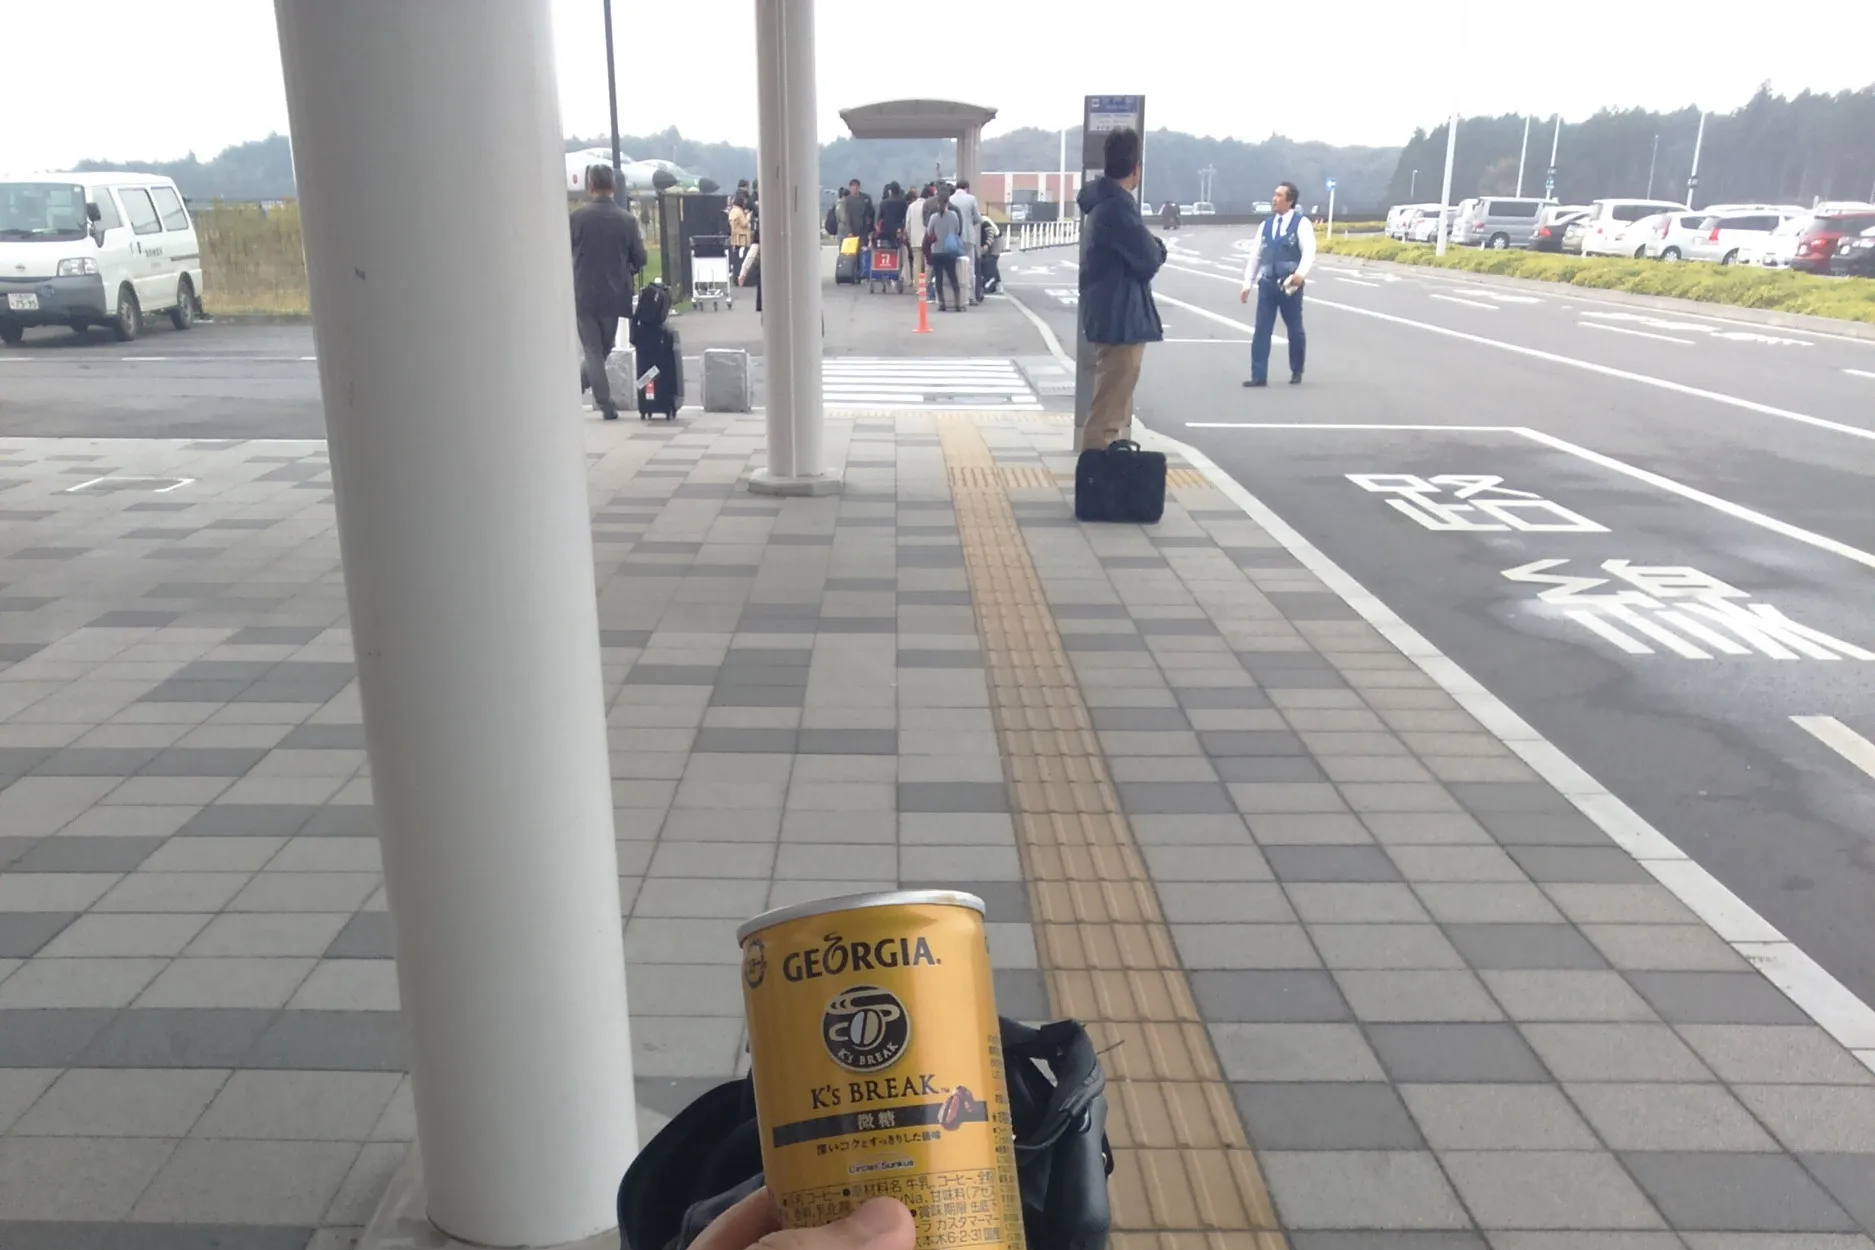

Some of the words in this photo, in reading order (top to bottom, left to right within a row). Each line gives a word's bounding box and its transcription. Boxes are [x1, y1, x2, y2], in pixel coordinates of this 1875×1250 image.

[859, 1041, 899, 1066] BREAK
[810, 1083, 842, 1110] K's
[848, 1073, 940, 1104] BREAK
[857, 1110, 896, 1130] 微糖
